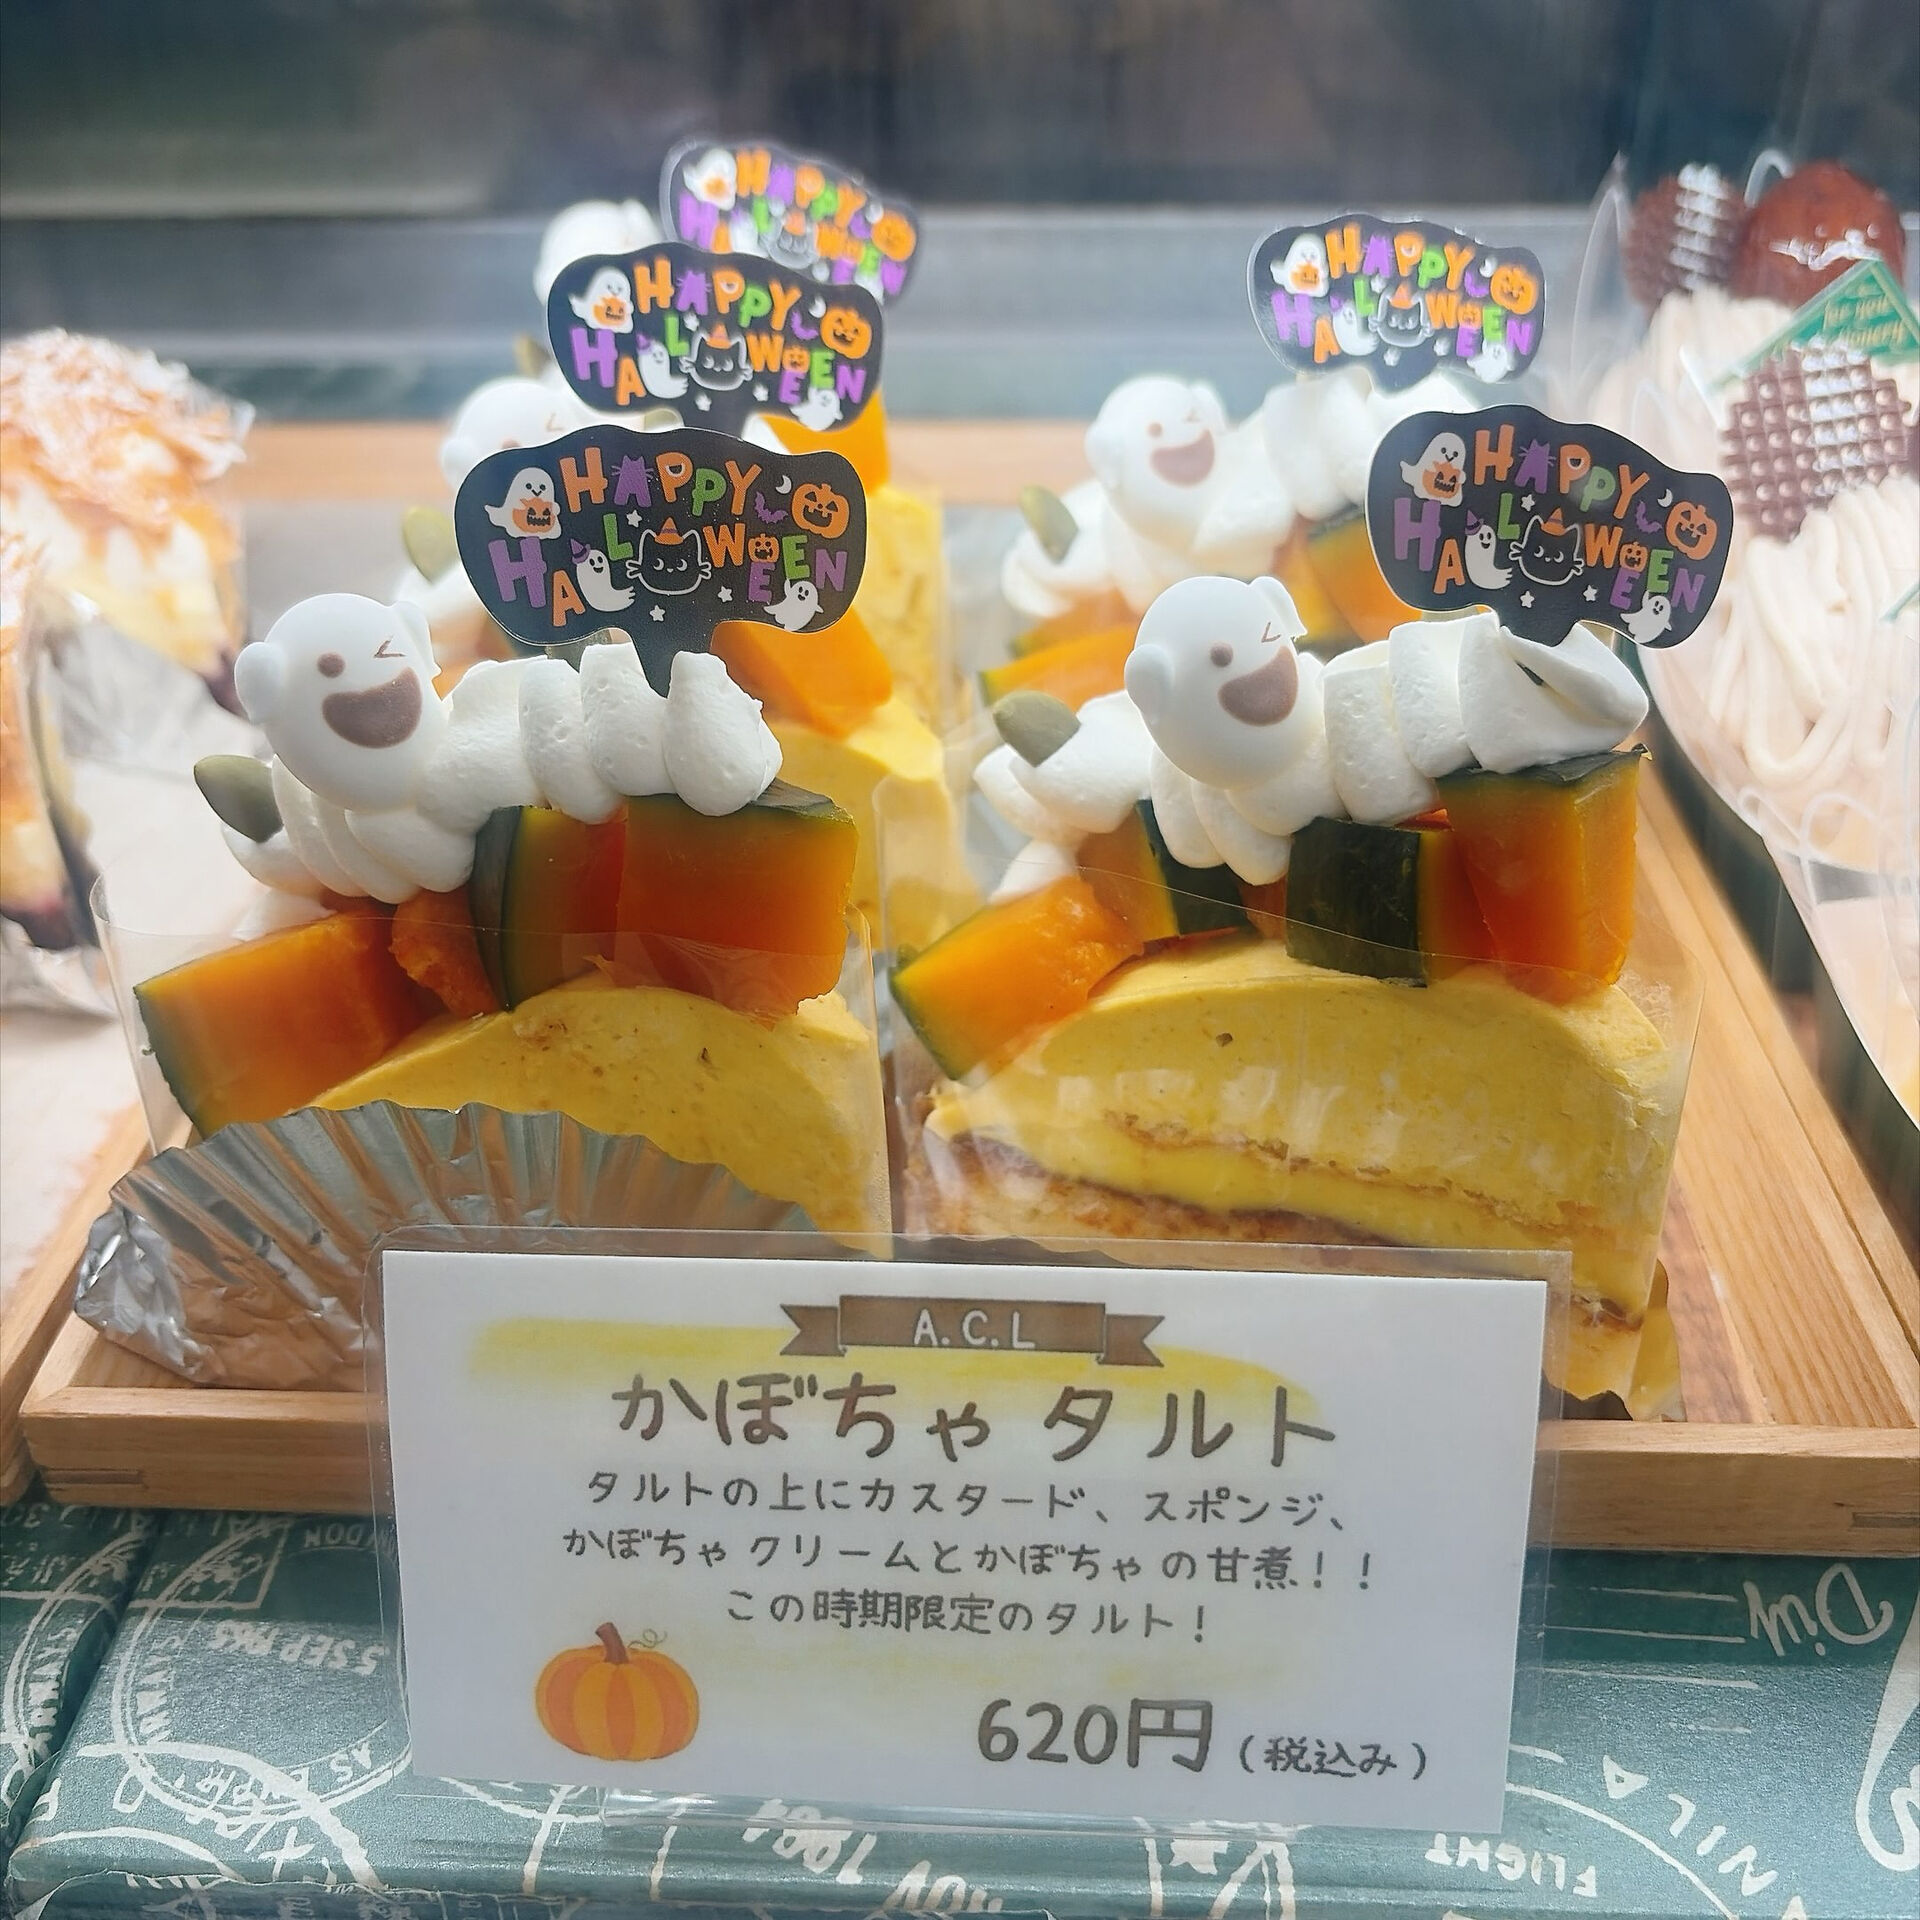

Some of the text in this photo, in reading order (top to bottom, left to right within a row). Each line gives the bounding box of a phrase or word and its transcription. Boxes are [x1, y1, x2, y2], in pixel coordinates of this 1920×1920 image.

[736, 150, 867, 229] HAPPY
[1324, 222, 1476, 291] HAPPY
[633, 257, 802, 330] HAPPY
[559, 446, 762, 517] HAPPY
[1473, 423, 1650, 520] HAPPY
[913, 1307, 1037, 1352] A.C.L
[611, 1371, 1336, 1467] かぼちゃタルト
[587, 1470, 1345, 1532] タルトの上にカスタード、スポンジ、
[726, 1588, 1207, 1643] この時期限定のタルト！
[977, 1697, 1213, 1772] 620円
[1424, 1832, 1598, 1898] FLIGHT
